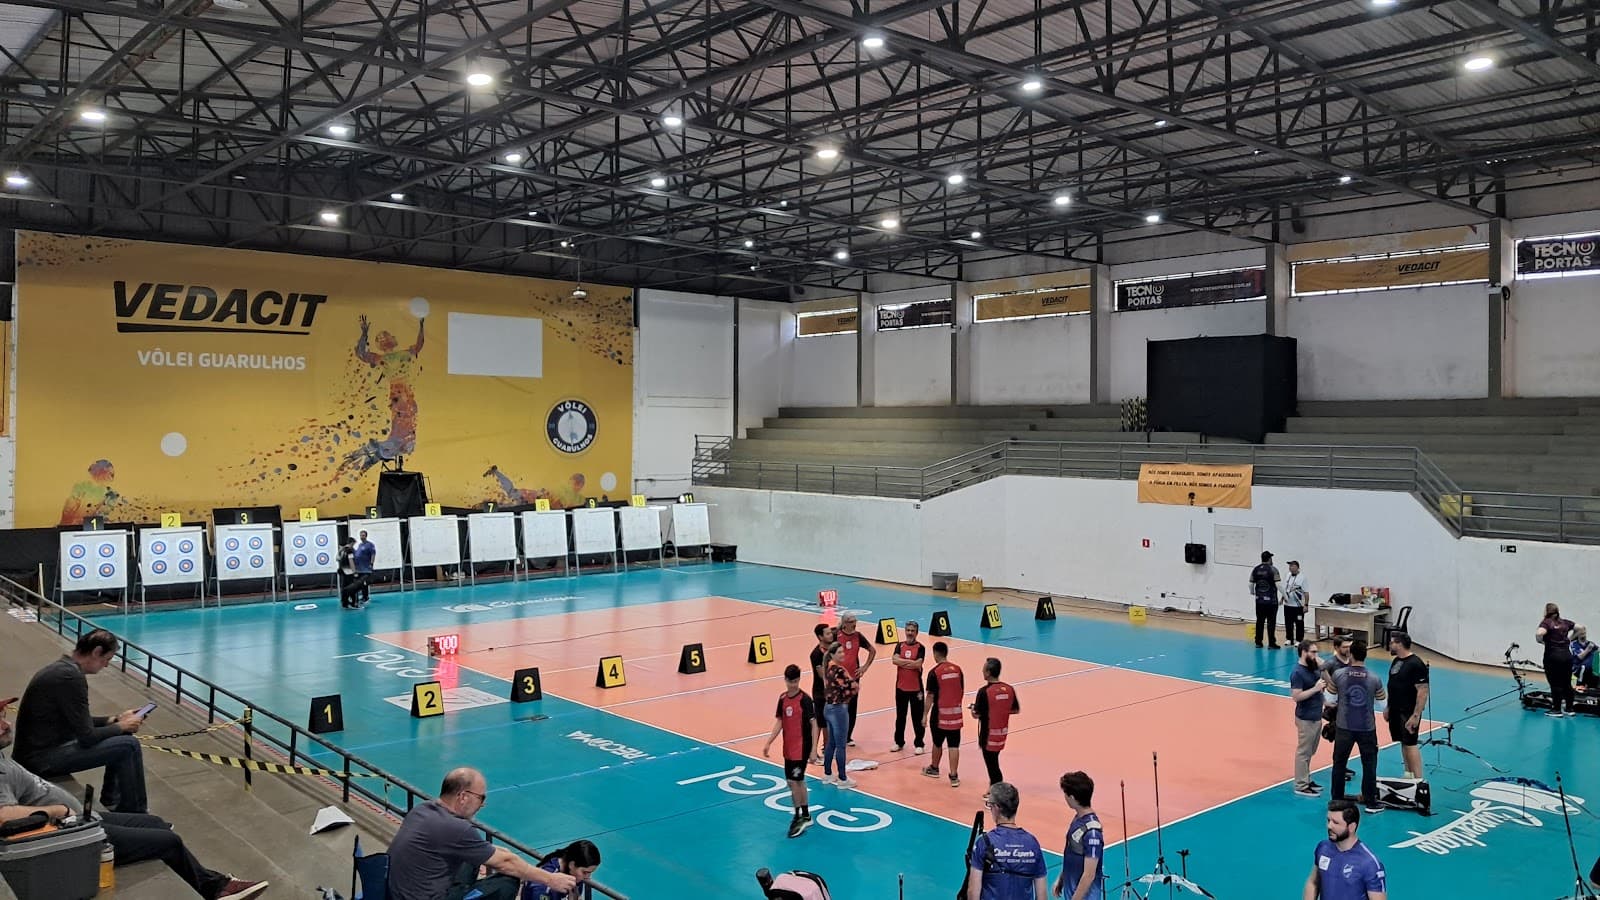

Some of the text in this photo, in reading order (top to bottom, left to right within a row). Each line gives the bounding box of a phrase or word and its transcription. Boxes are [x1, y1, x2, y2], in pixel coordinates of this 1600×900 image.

[1398, 261, 1441, 272] VEDACIT
[1534, 256, 1592, 270] PORTAS
[113, 281, 328, 327] VEDACIT
[1127, 296, 1162, 307] PORTAS
[137, 348, 306, 371] VÔLEI GUARULHOS
[557, 401, 588, 414] VÔLEI
[552, 434, 593, 452] GUARULHOS
[589, 499, 595, 508] 9
[634, 496, 644, 506] 10
[686, 494, 693, 503] 11
[429, 506, 437, 515] 6
[488, 503, 494, 513] 7
[540, 501, 546, 511] 8
[240, 513, 248, 524] 3
[305, 510, 312, 520] 4
[370, 508, 377, 518] 5
[91, 518, 97, 530] 1
[167, 516, 175, 527] 2
[1044, 602, 1054, 615] 11
[988, 609, 999, 622] 10
[939, 616, 947, 630] 9
[886, 624, 894, 638] 8
[759, 641, 768, 656] 6
[690, 650, 701, 667] 5
[609, 663, 619, 679] 4
[522, 676, 535, 694] 3
[424, 691, 436, 708] 2
[324, 704, 333, 724] 1
